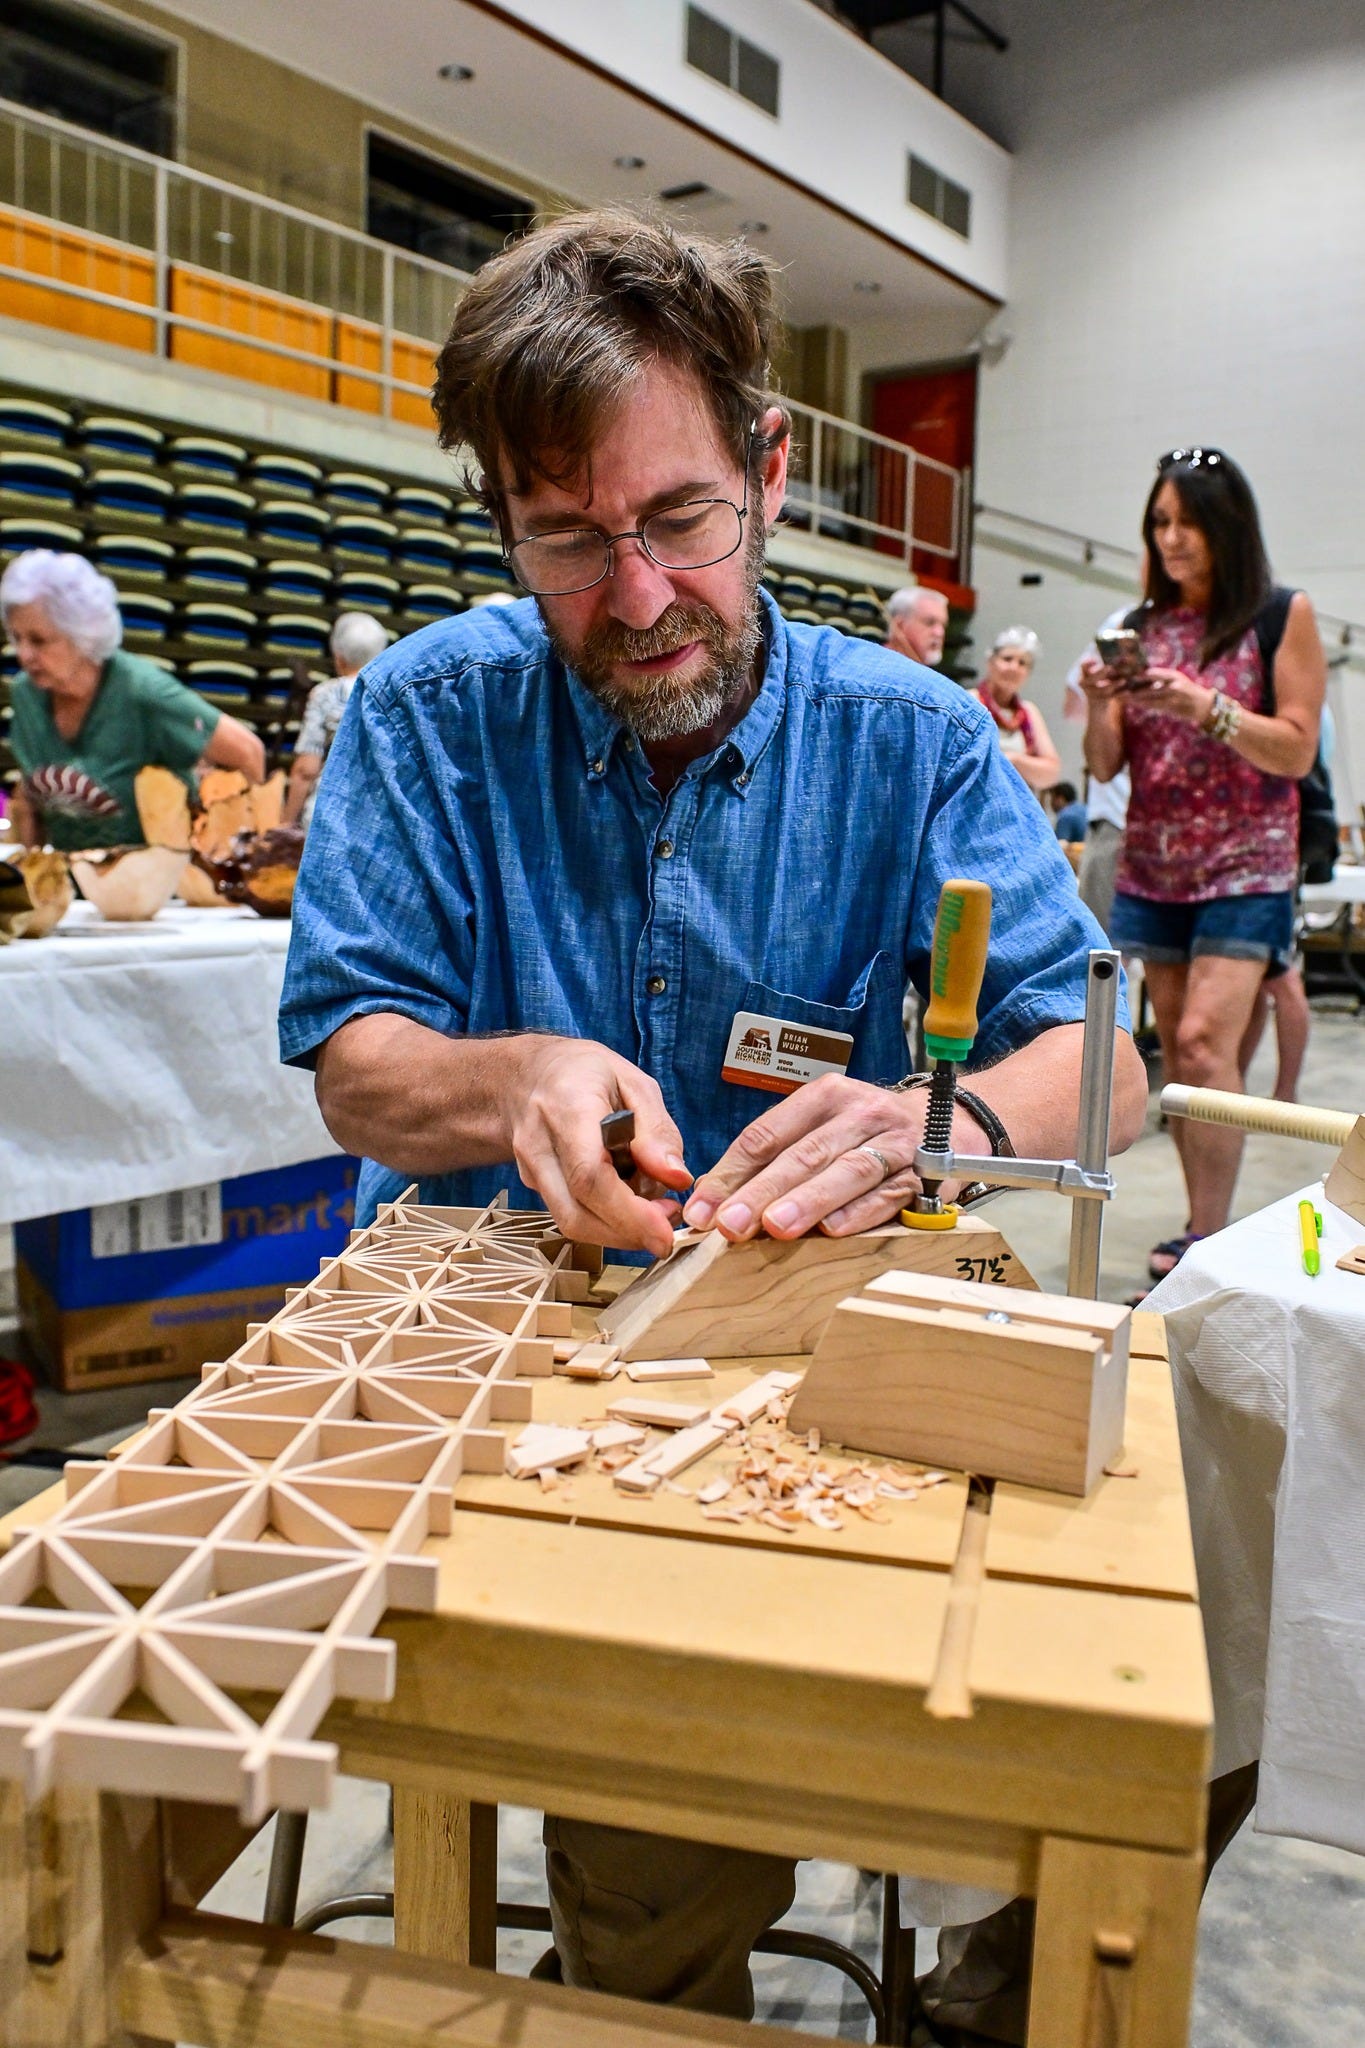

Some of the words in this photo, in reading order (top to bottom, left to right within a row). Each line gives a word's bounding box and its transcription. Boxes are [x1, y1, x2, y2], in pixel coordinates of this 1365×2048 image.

[783, 1032, 808, 1044] BRIAN
[737, 1045, 772, 1058] SOUTHERN
[782, 1041, 809, 1053] WURST
[734, 1051, 771, 1066] HIGHLAND
[778, 1059, 794, 1067] WOOD
[222, 1190, 332, 1241] mart
